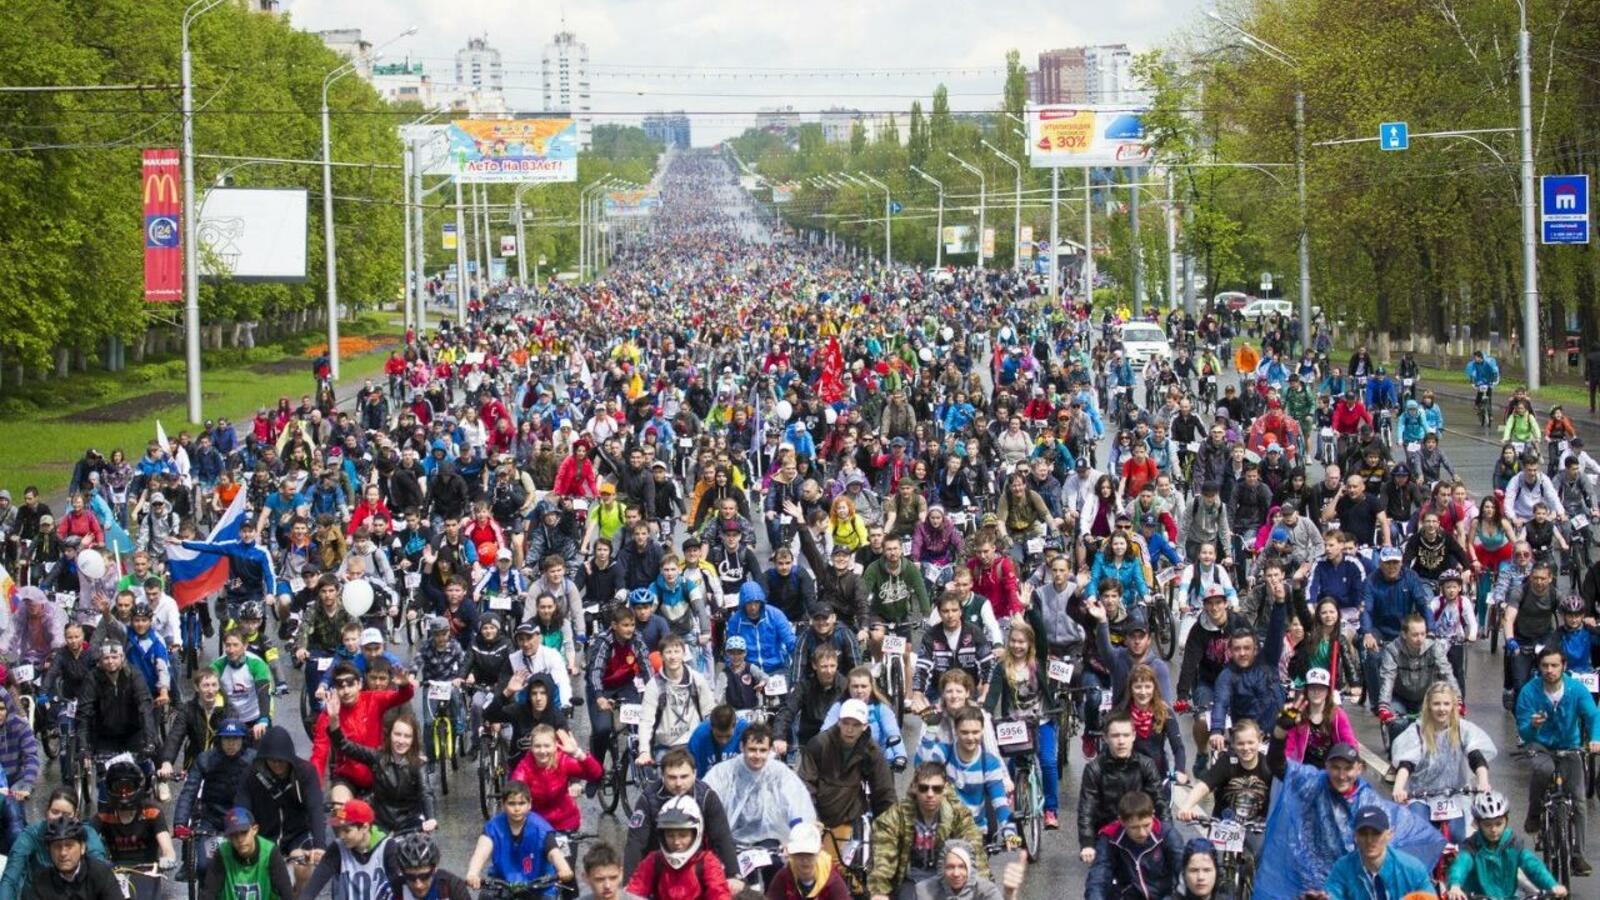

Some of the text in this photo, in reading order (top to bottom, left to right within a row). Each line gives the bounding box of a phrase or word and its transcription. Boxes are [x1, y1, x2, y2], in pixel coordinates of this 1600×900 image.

[1056, 135, 1087, 148] 30%
[999, 726, 1023, 737] 5956
[1437, 799, 1454, 811] 871
